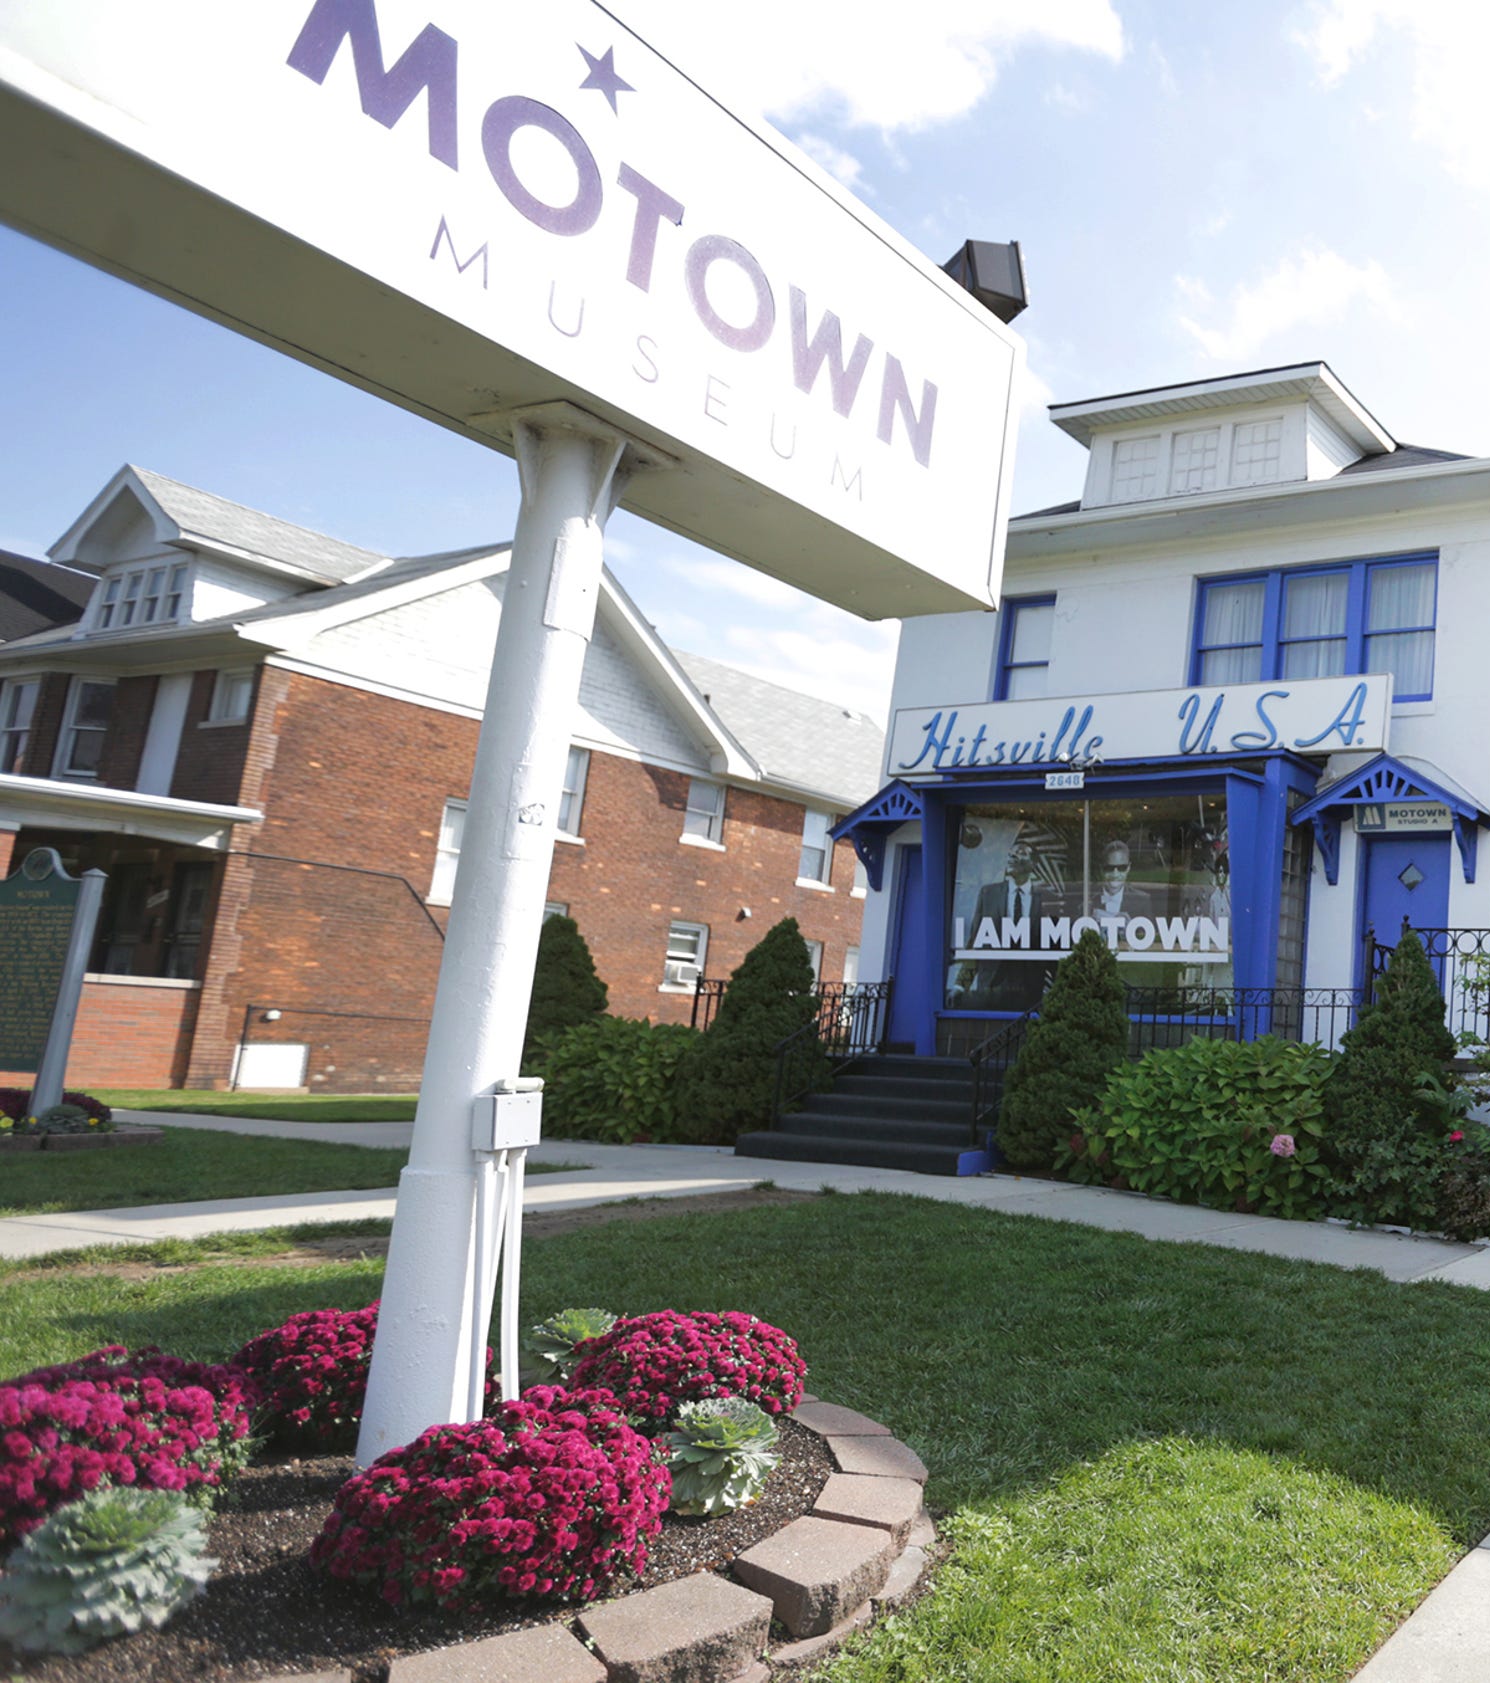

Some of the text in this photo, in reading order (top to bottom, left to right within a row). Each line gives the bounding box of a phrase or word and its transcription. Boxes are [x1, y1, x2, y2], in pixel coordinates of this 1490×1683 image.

[285, 0, 938, 468] MOTOWN
[430, 215, 863, 502] MUSEUM
[898, 704, 1104, 769] Hitsville
[1389, 808, 1447, 818] MOTOWN
[955, 917, 964, 949] I
[973, 917, 1030, 949] AM
